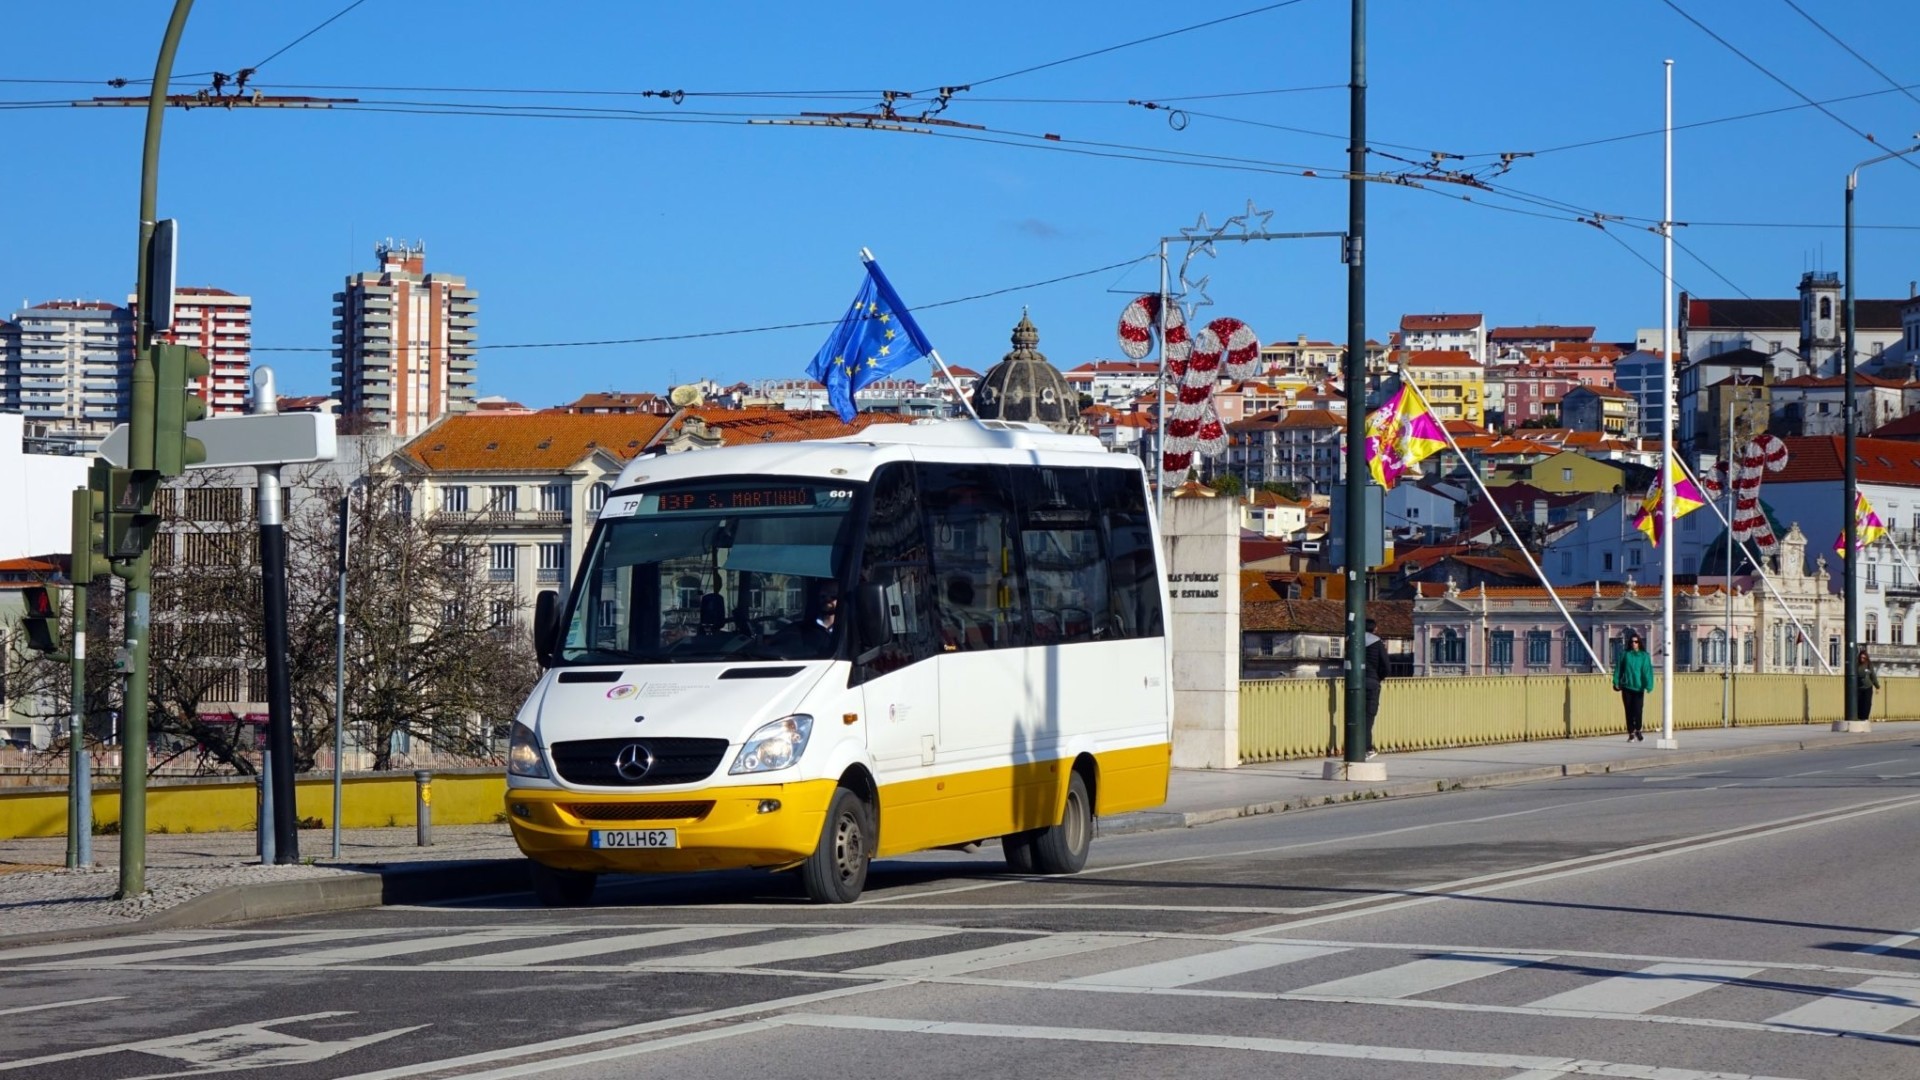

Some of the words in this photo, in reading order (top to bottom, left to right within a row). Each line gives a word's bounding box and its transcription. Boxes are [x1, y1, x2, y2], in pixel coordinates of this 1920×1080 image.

[829, 490, 853, 498] 601
[623, 501, 639, 512] TP
[661, 495, 694, 509] 13P
[709, 493, 723, 508] S.
[1184, 571, 1219, 582] PÚBLICAS
[1181, 590, 1219, 598] ESTRADAS
[607, 831, 668, 847] 02LH62
